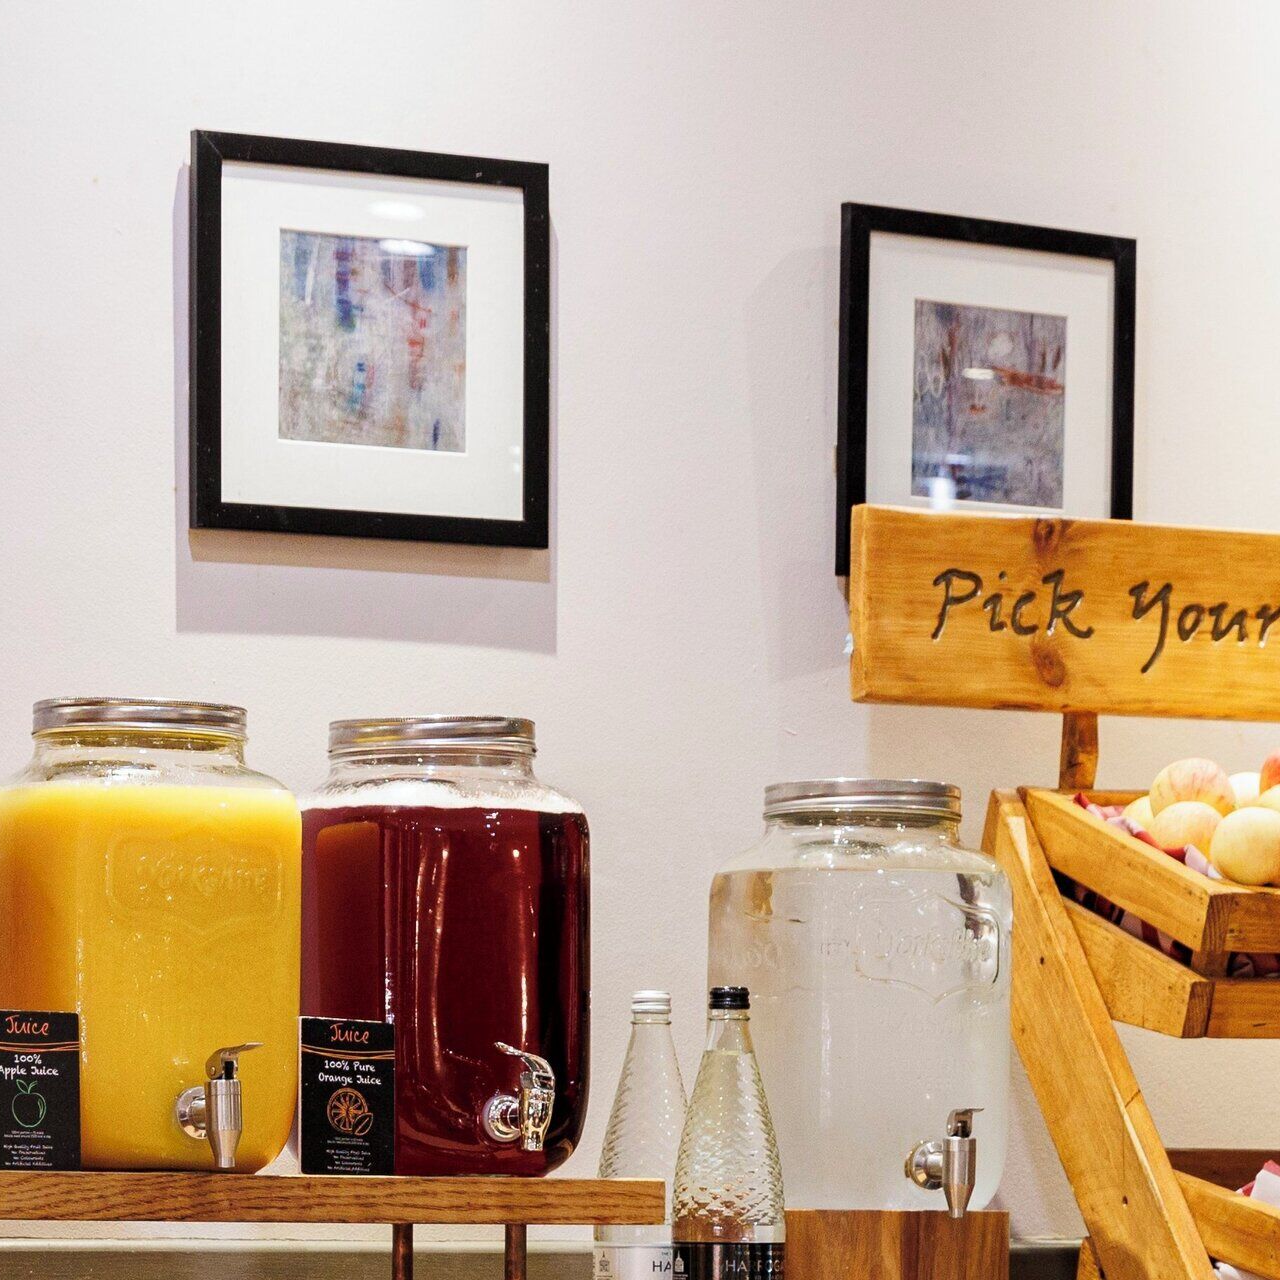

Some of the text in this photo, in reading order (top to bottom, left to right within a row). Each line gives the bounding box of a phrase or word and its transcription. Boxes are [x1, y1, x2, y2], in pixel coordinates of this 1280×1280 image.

[930, 566, 1095, 641] Pick
[5, 1014, 50, 1036] Juice
[330, 1023, 370, 1044] Juice
[13, 1053, 42, 1065] 100%
[30, 1066, 60, 1077] Juice
[324, 1060, 376, 1072] 100% Pure
[318, 1073, 382, 1086] Orange Juice
